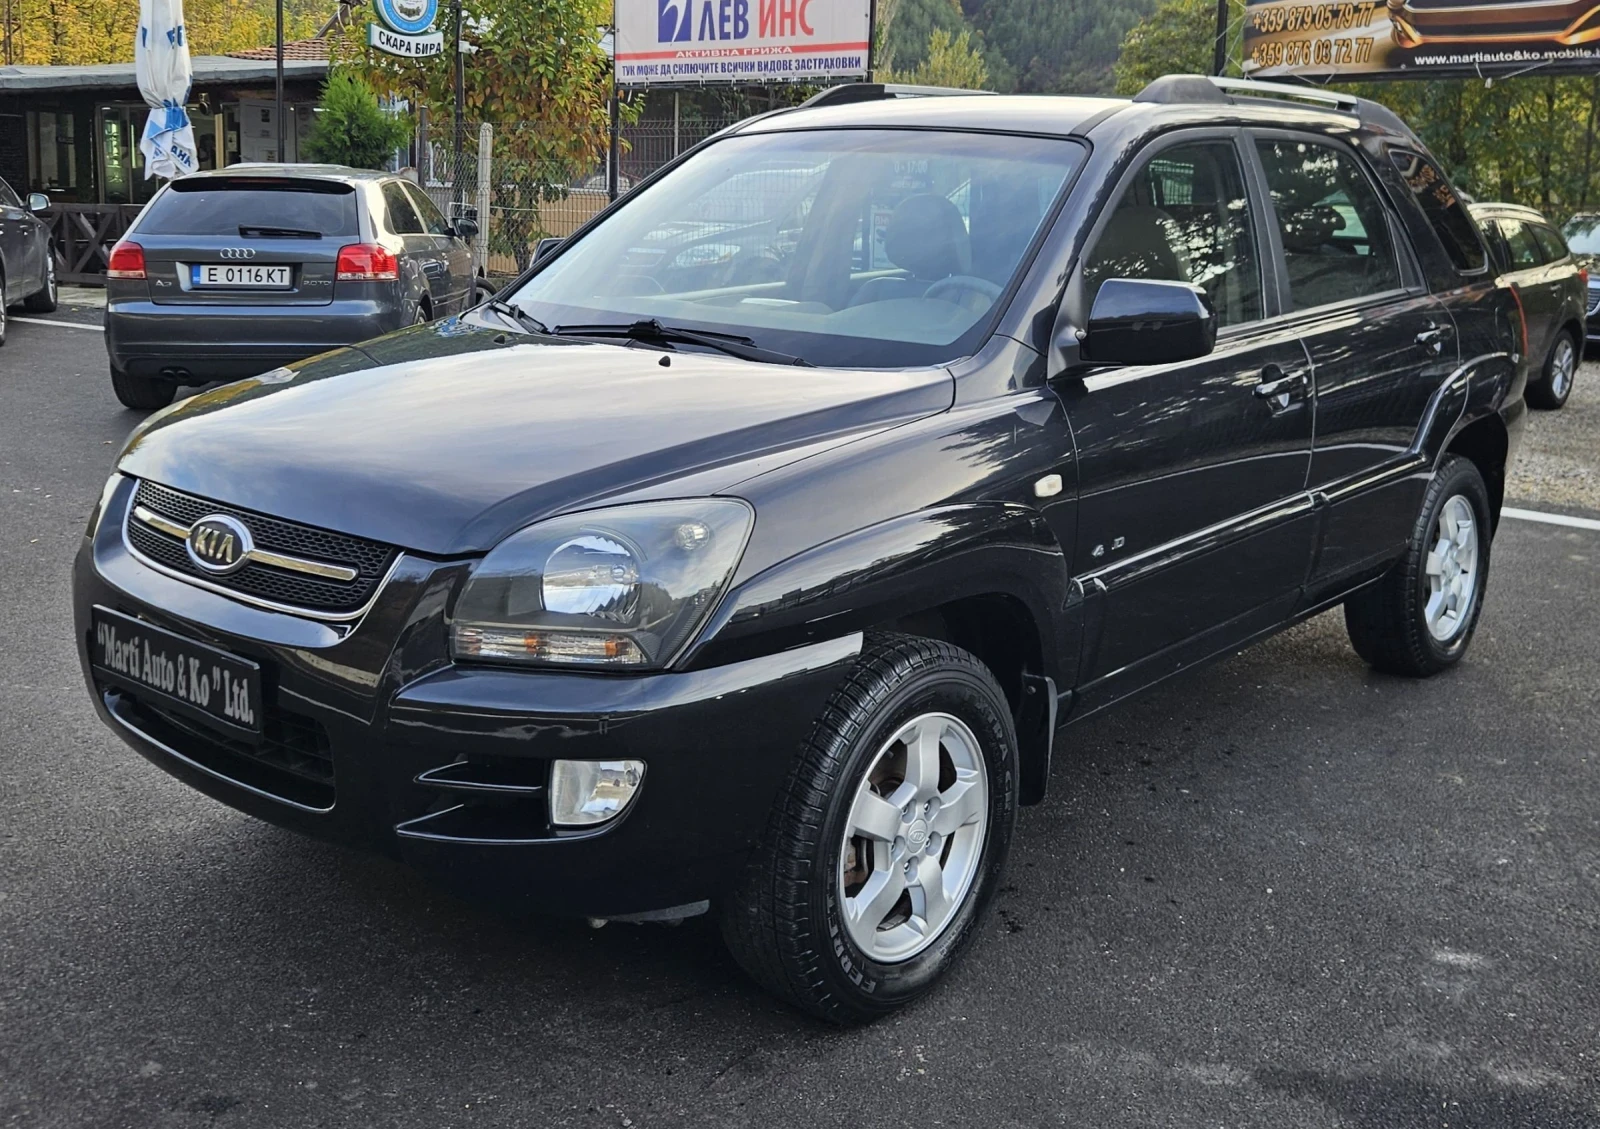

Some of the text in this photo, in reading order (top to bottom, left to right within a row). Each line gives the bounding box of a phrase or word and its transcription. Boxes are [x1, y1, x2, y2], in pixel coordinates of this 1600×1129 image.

[698, 0, 814, 41] ЛЕВ ИНС
[1253, 2, 1375, 33] +359 879 05 79 77
[379, 31, 441, 55] СКАРА БИРА
[676, 46, 793, 58] АКТИВНА ГРИЖА
[1252, 37, 1374, 67] +359 876 03 72 77
[622, 56, 861, 76] ТУК МОЖЕ ДА СКЛЮЧИТЕ ВСИЧКИ ВИДОВЕ ЗАСТРАХОВКИ
[208, 268, 218, 282] E
[195, 526, 234, 563] KIA
[142, 639, 175, 693] Auto
[177, 653, 187, 698] &
[223, 669, 254, 725] Ltd.
